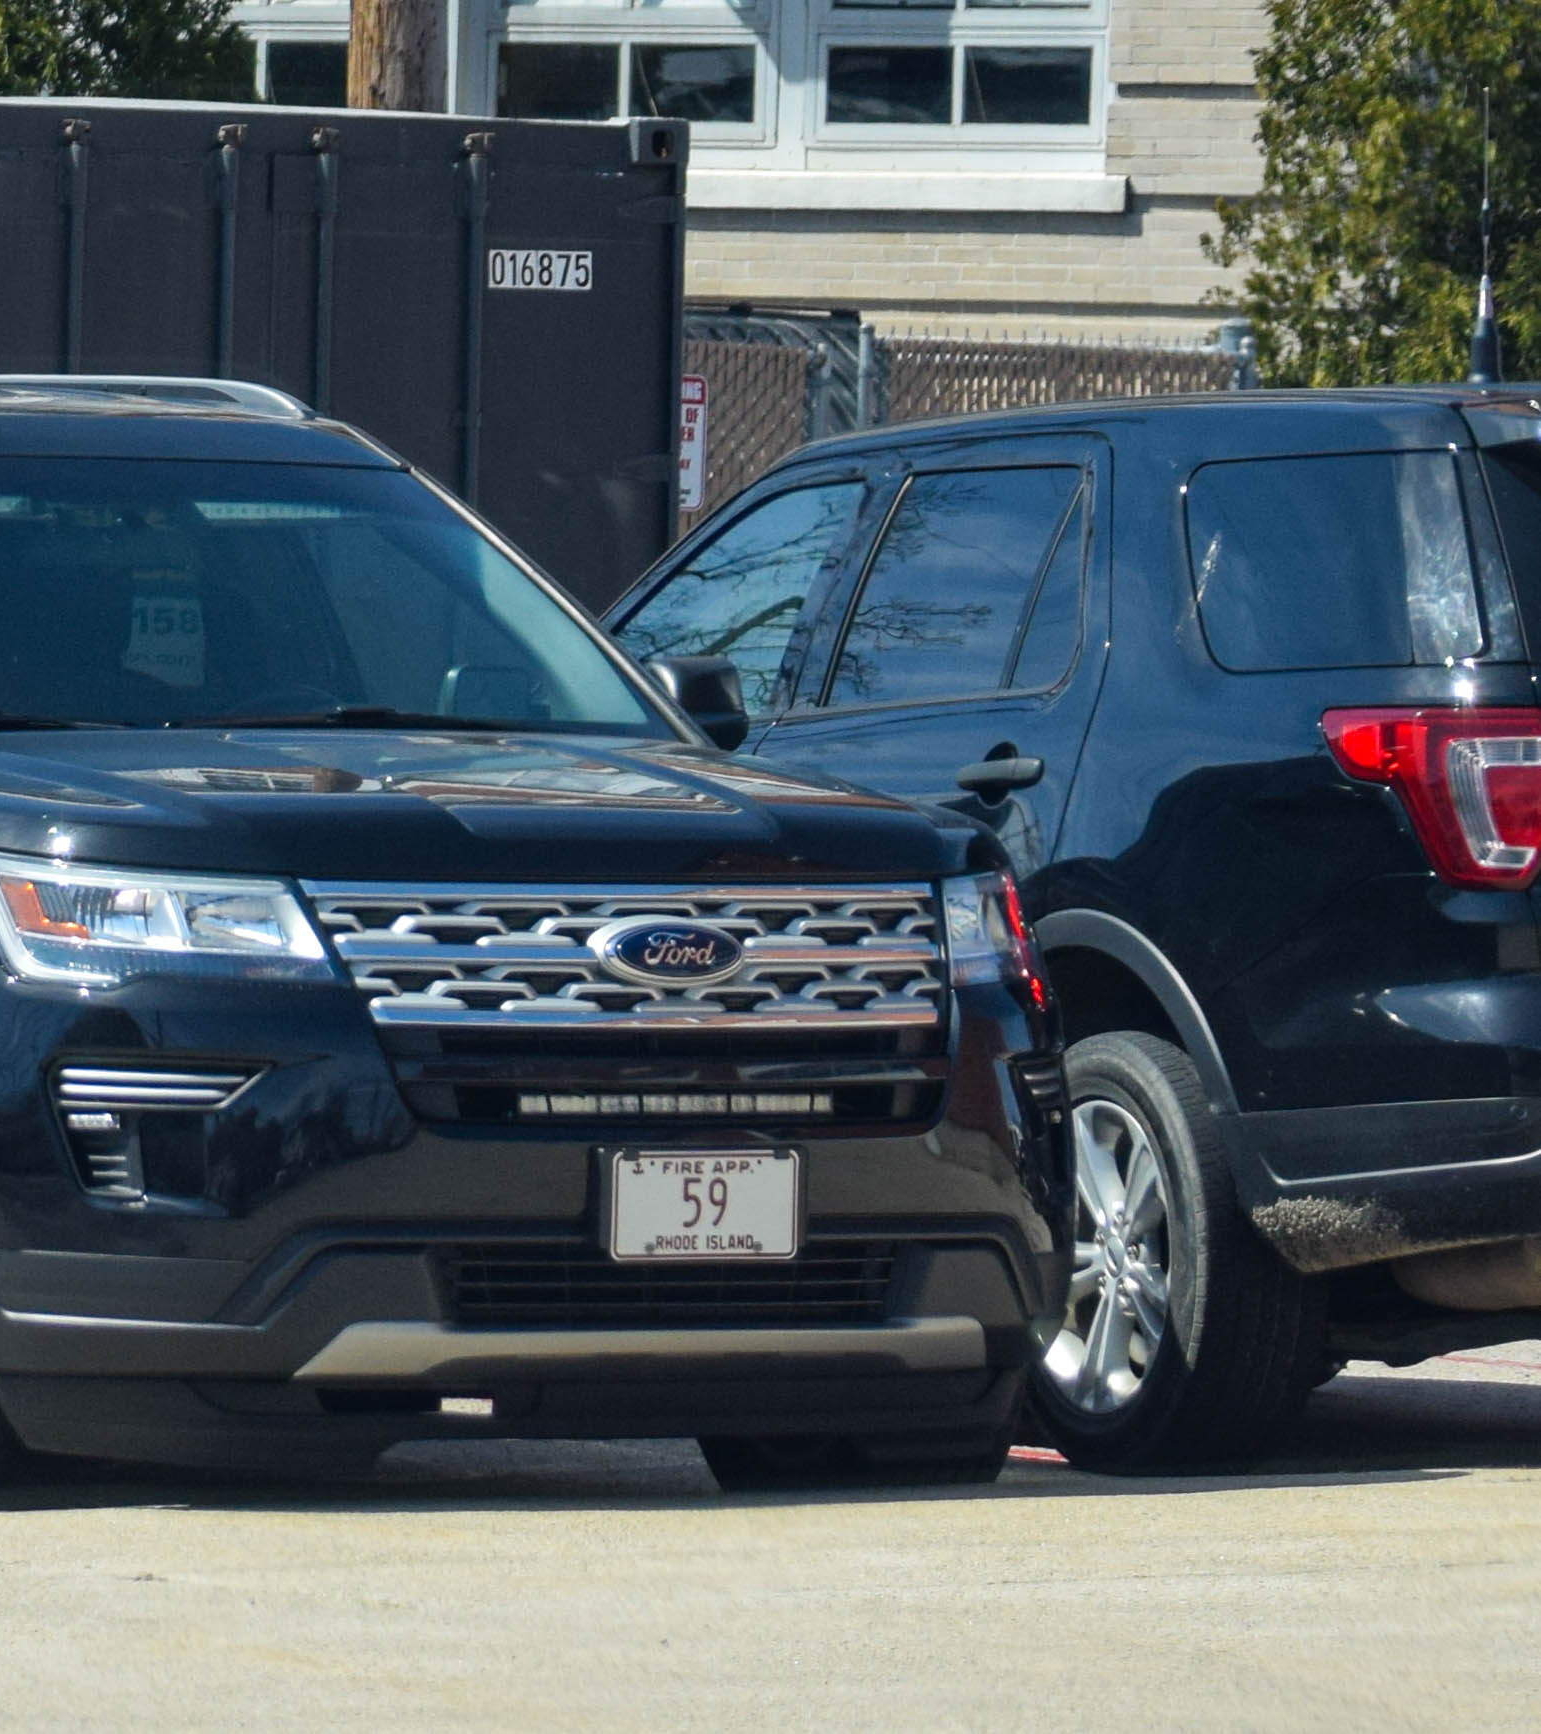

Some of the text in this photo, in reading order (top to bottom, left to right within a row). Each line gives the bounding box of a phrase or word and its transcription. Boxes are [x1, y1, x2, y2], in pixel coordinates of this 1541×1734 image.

[492, 251, 590, 287] 016875
[644, 931, 716, 966] Ford
[662, 1159, 754, 1175] FIRE APP.
[682, 1177, 728, 1228] 59
[655, 1234, 754, 1250] RHODE ISLAND
